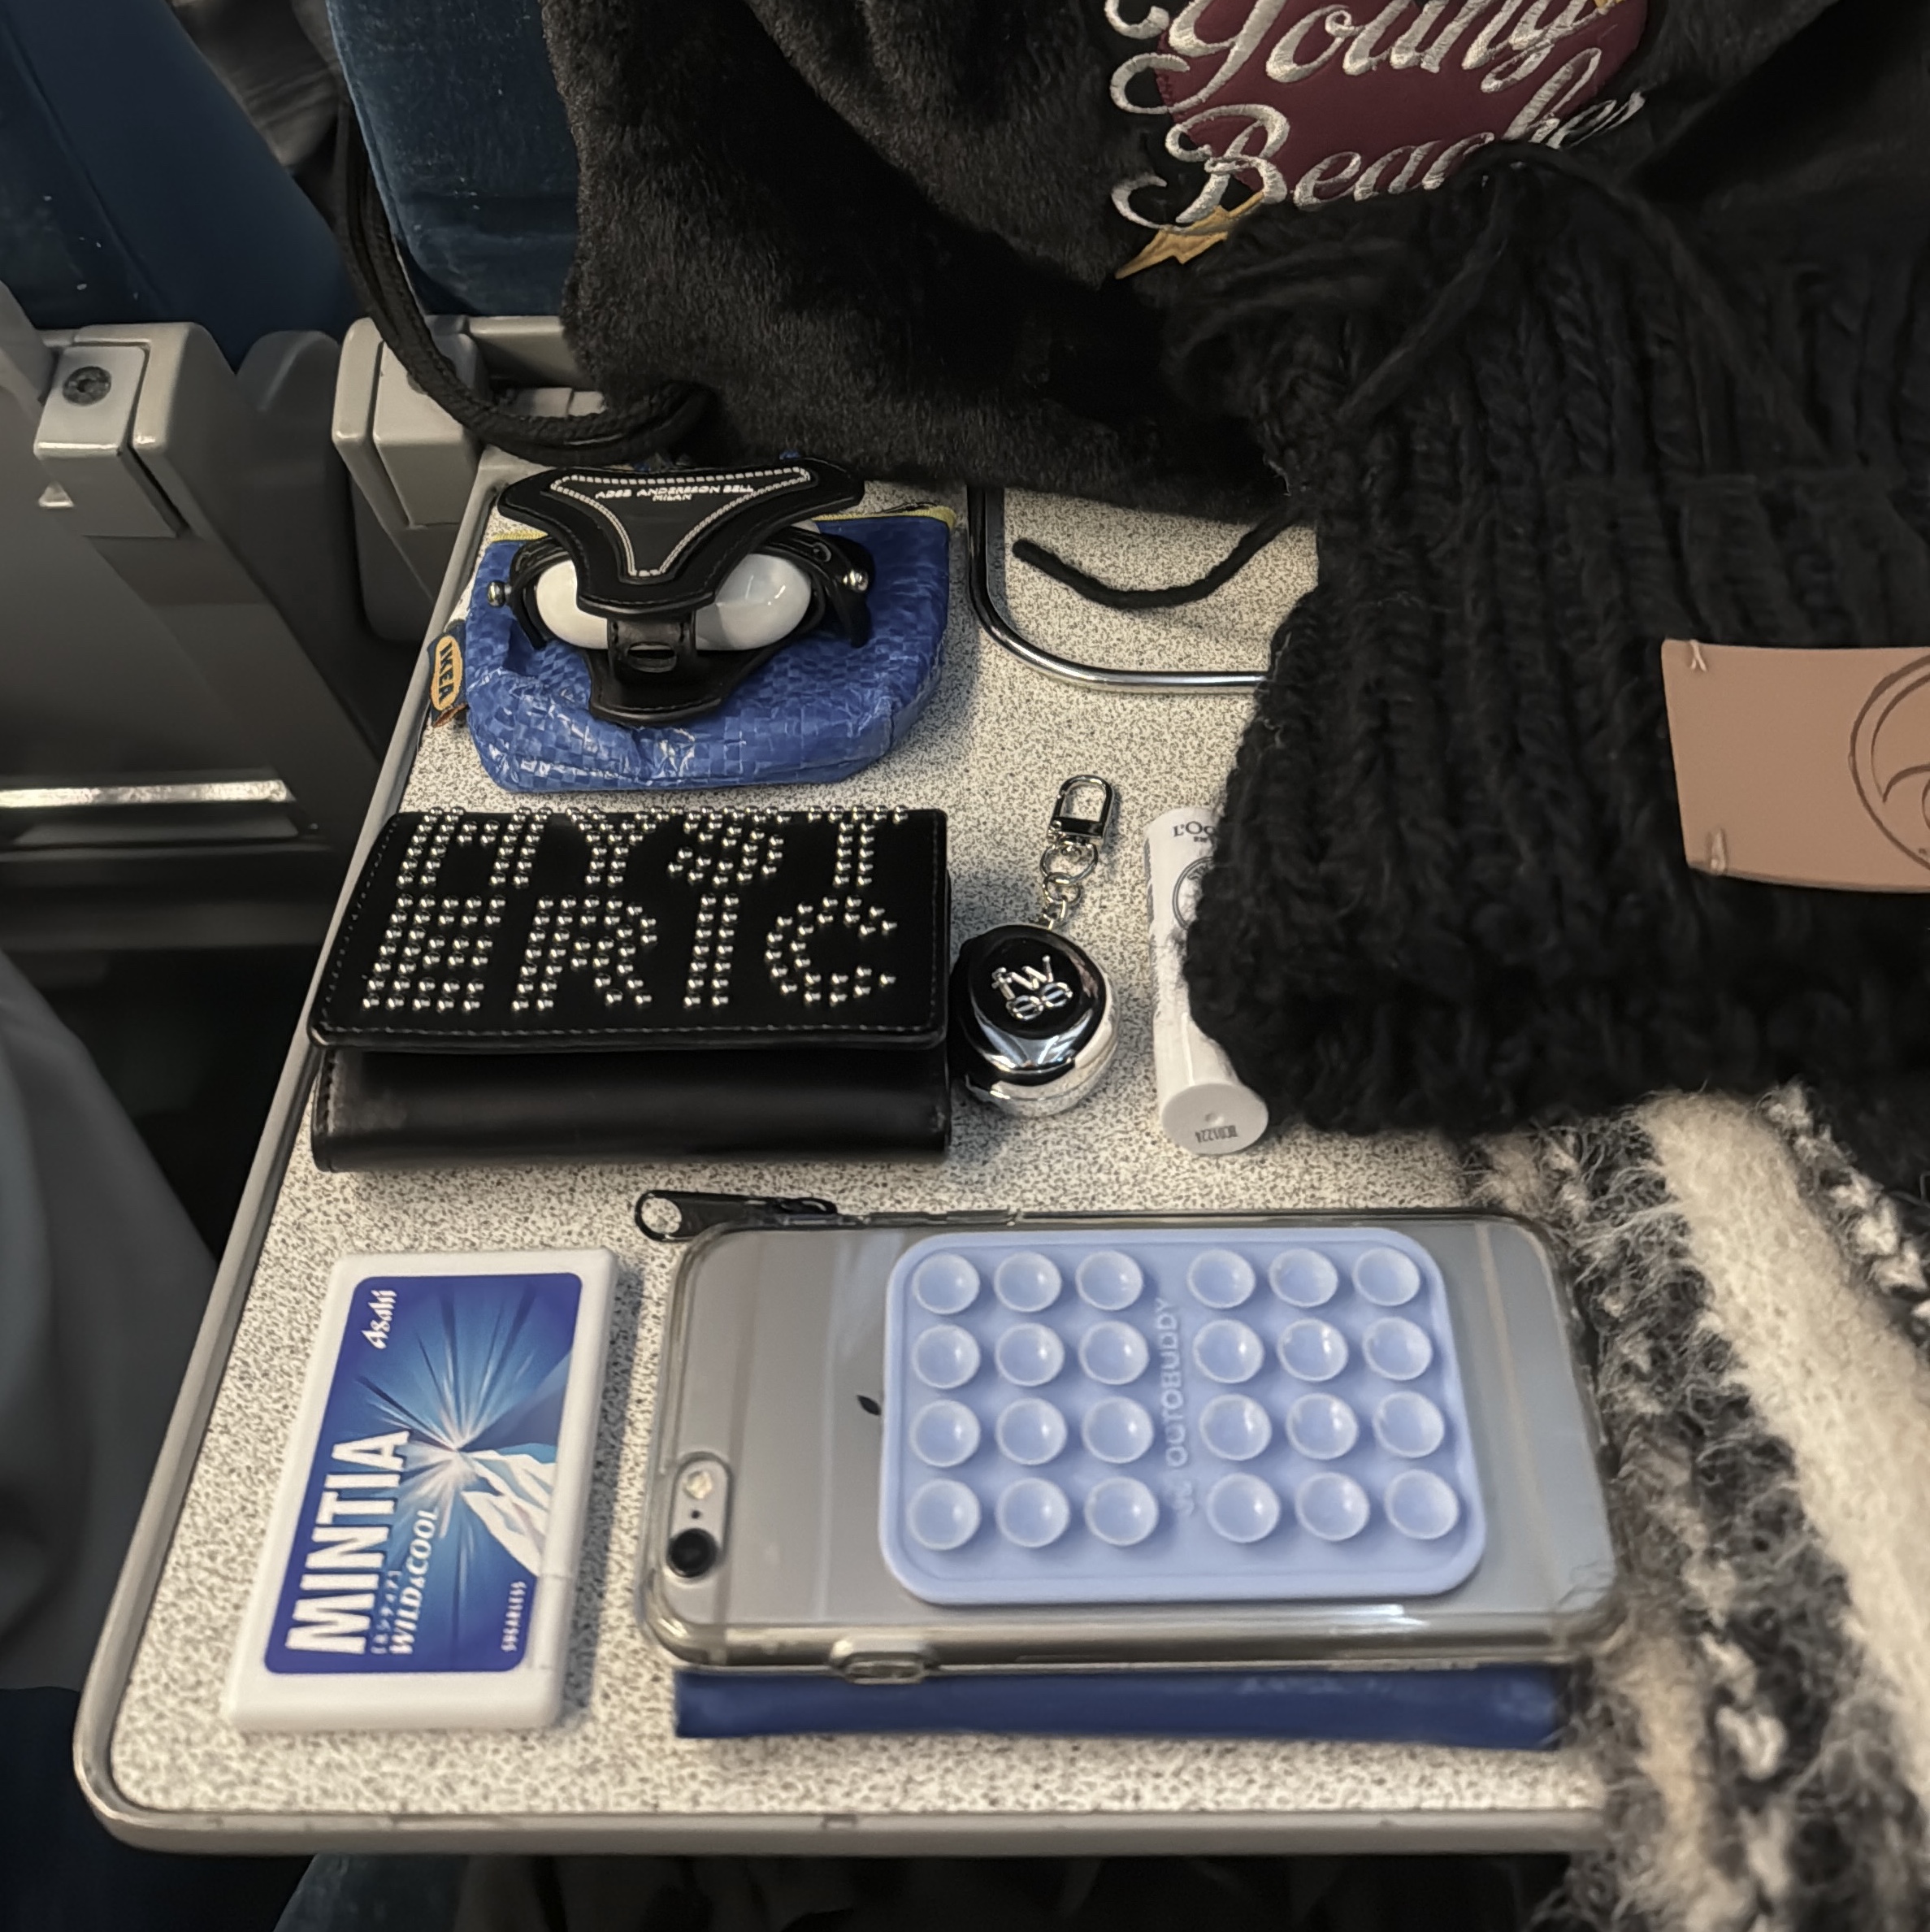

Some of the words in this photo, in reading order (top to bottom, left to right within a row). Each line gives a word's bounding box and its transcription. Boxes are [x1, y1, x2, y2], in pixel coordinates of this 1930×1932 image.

[723, 484, 754, 494] BELL
[438, 640, 455, 706] IKEA
[361, 892, 899, 1013] ERIC
[360, 1289, 397, 1350] Asahi
[284, 1430, 411, 1655] MINTIA
